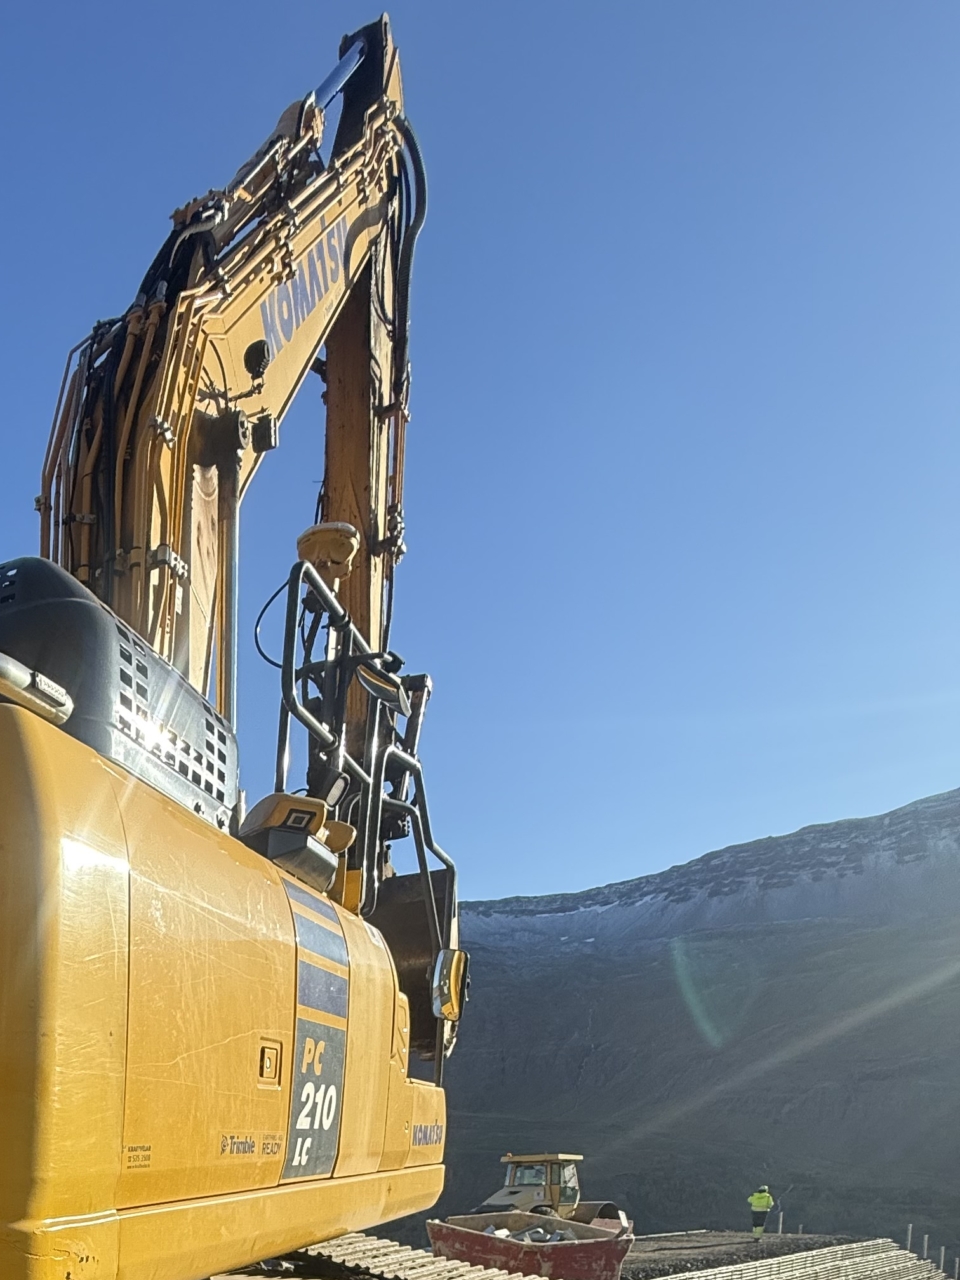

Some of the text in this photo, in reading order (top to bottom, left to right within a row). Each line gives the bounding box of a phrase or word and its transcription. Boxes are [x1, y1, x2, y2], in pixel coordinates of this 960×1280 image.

[301, 1037, 325, 1076] PC
[296, 1082, 337, 1131] 210
[229, 1135, 256, 1155] Trimble
[412, 1119, 443, 1147] KOMATSU
[262, 1142, 282, 1155] READY
[292, 1137, 312, 1166] LC
